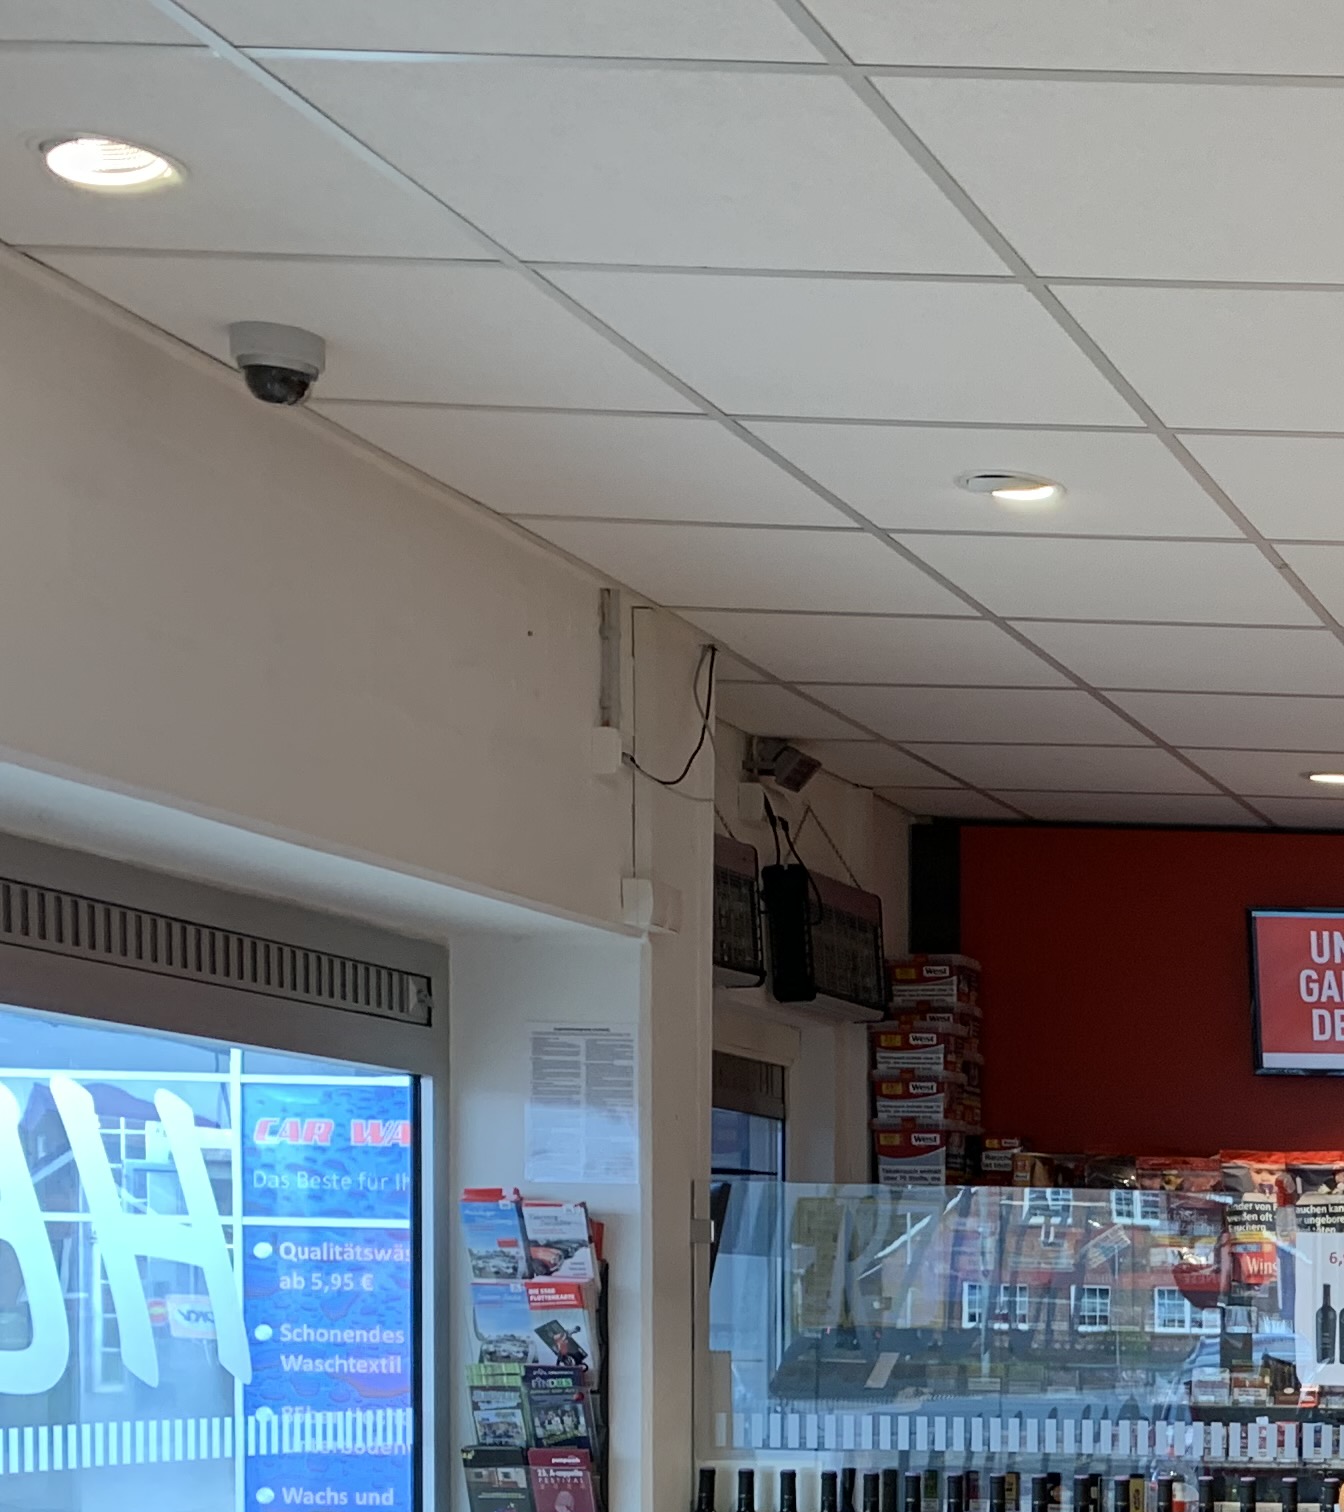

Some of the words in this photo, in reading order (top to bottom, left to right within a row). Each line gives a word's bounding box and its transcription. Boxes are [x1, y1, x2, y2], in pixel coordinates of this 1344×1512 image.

[253, 1117, 335, 1146] CAR
[253, 1171, 290, 1189] Das
[297, 1171, 352, 1190] Beste
[359, 1172, 390, 1191] für
[280, 1273, 306, 1291] ab
[311, 1273, 355, 1294] 5,95
[361, 1274, 375, 1291] €
[280, 1323, 405, 1344] Schonendes
[280, 1354, 402, 1374] Waschtextil
[282, 1486, 348, 1507] Wachs
[355, 1487, 394, 1507] und
